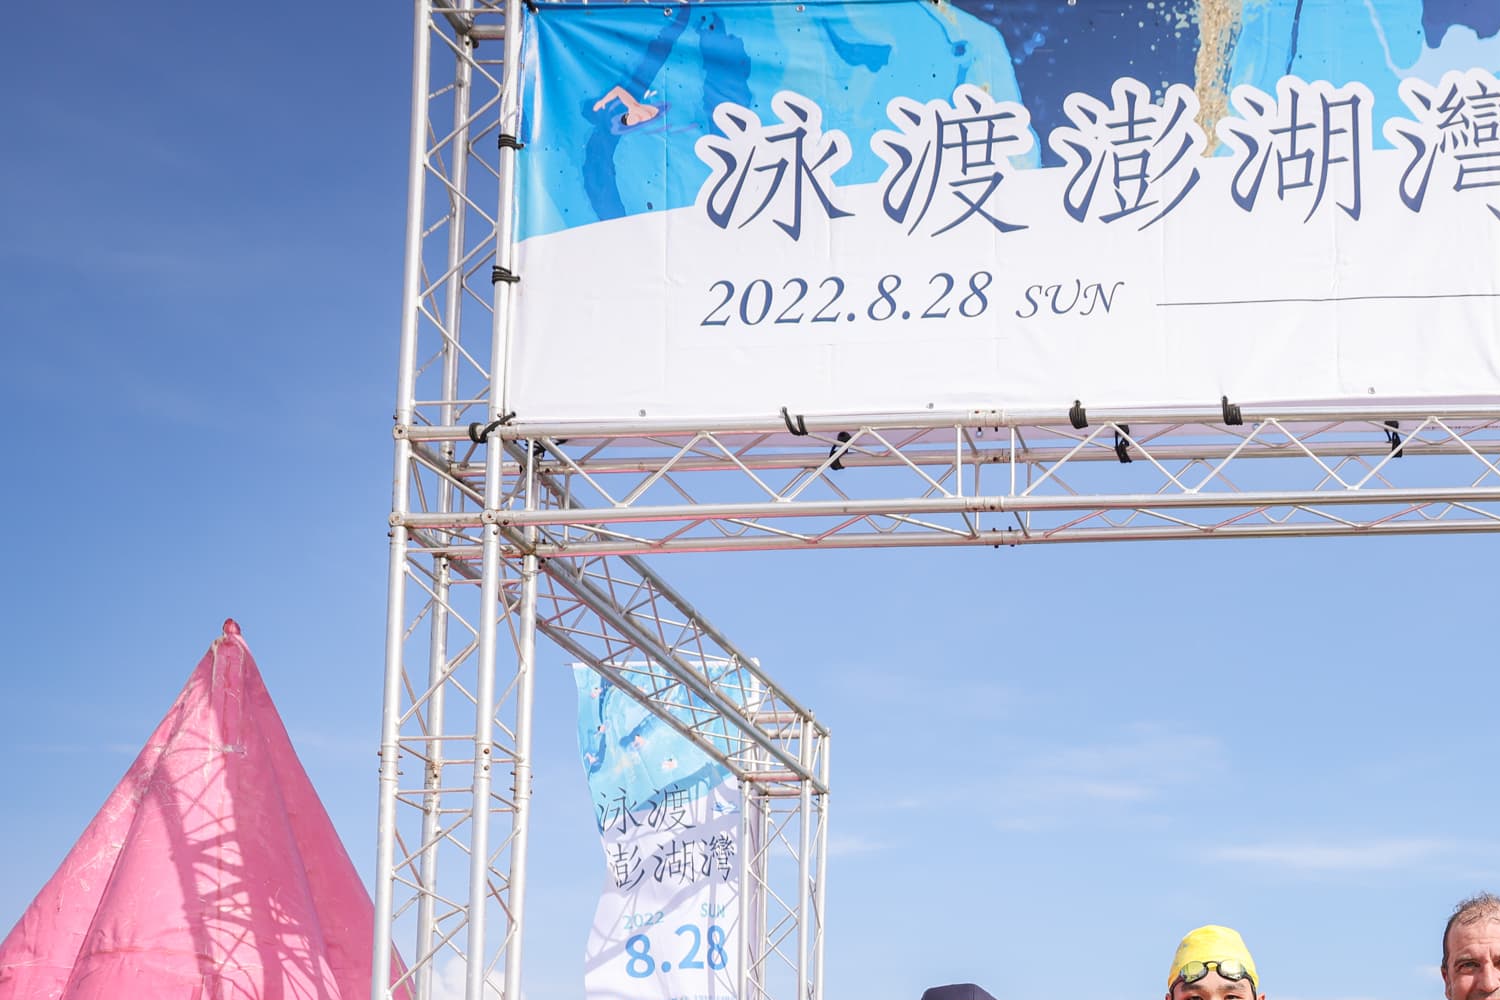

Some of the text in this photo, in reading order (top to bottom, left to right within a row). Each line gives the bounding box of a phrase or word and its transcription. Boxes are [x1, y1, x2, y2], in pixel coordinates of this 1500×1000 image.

[700, 270, 1125, 327] 2022.8.28 SUN
[598, 784, 697, 835] 泳渡
[606, 834, 735, 892] 澎湖灣
[623, 902, 726, 931] 2022 SUN
[625, 923, 729, 979] 8.28
